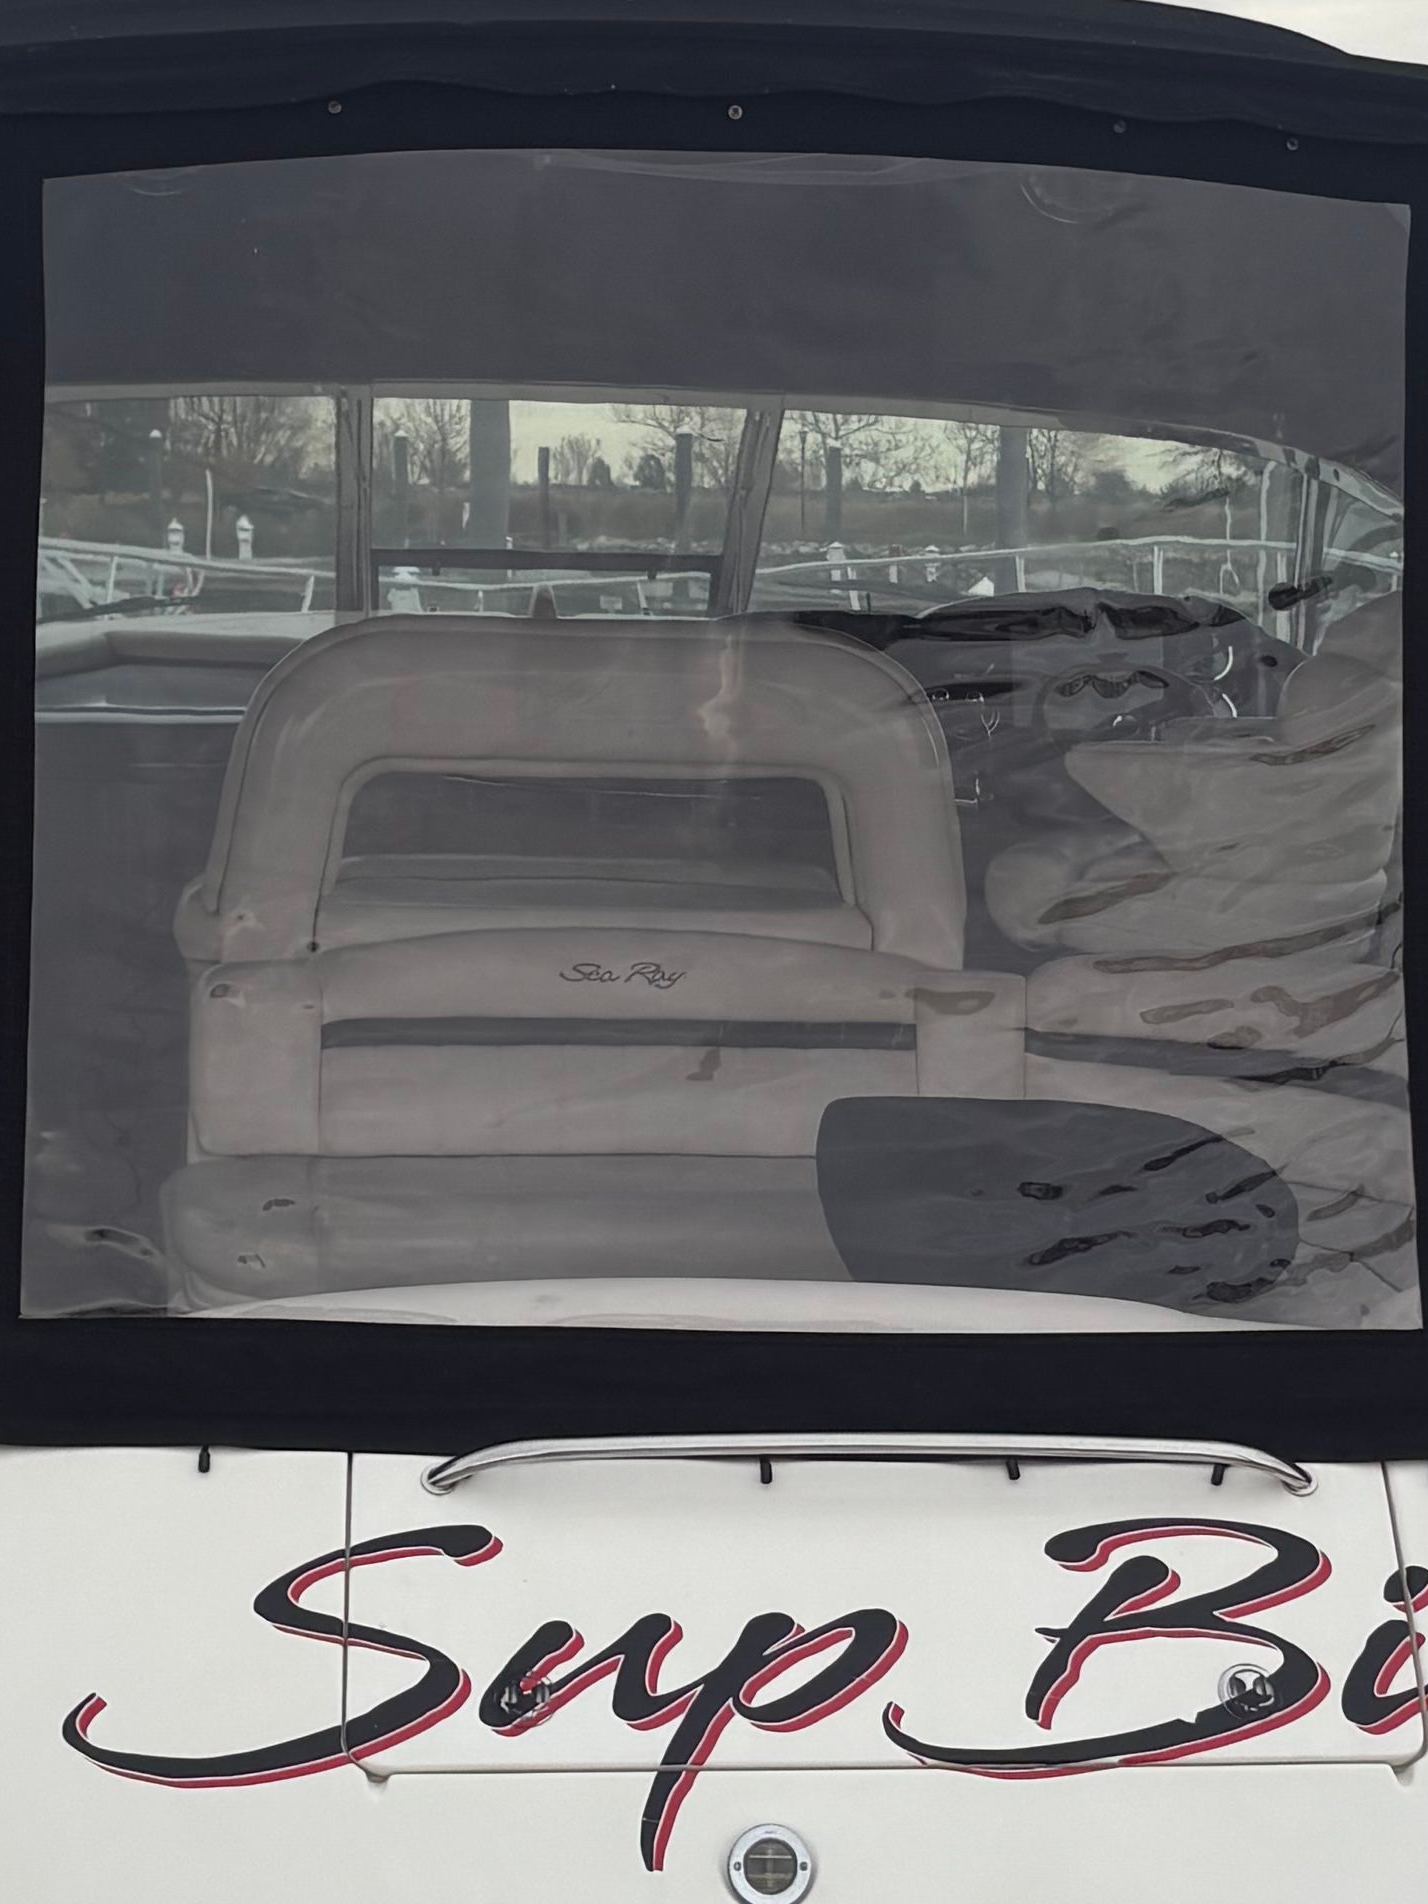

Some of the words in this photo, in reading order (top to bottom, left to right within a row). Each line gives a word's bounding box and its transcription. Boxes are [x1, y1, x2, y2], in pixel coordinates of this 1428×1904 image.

[558, 962, 621, 983] Sea
[623, 961, 688, 989] Ray
[62, 1524, 908, 1873] Sup
